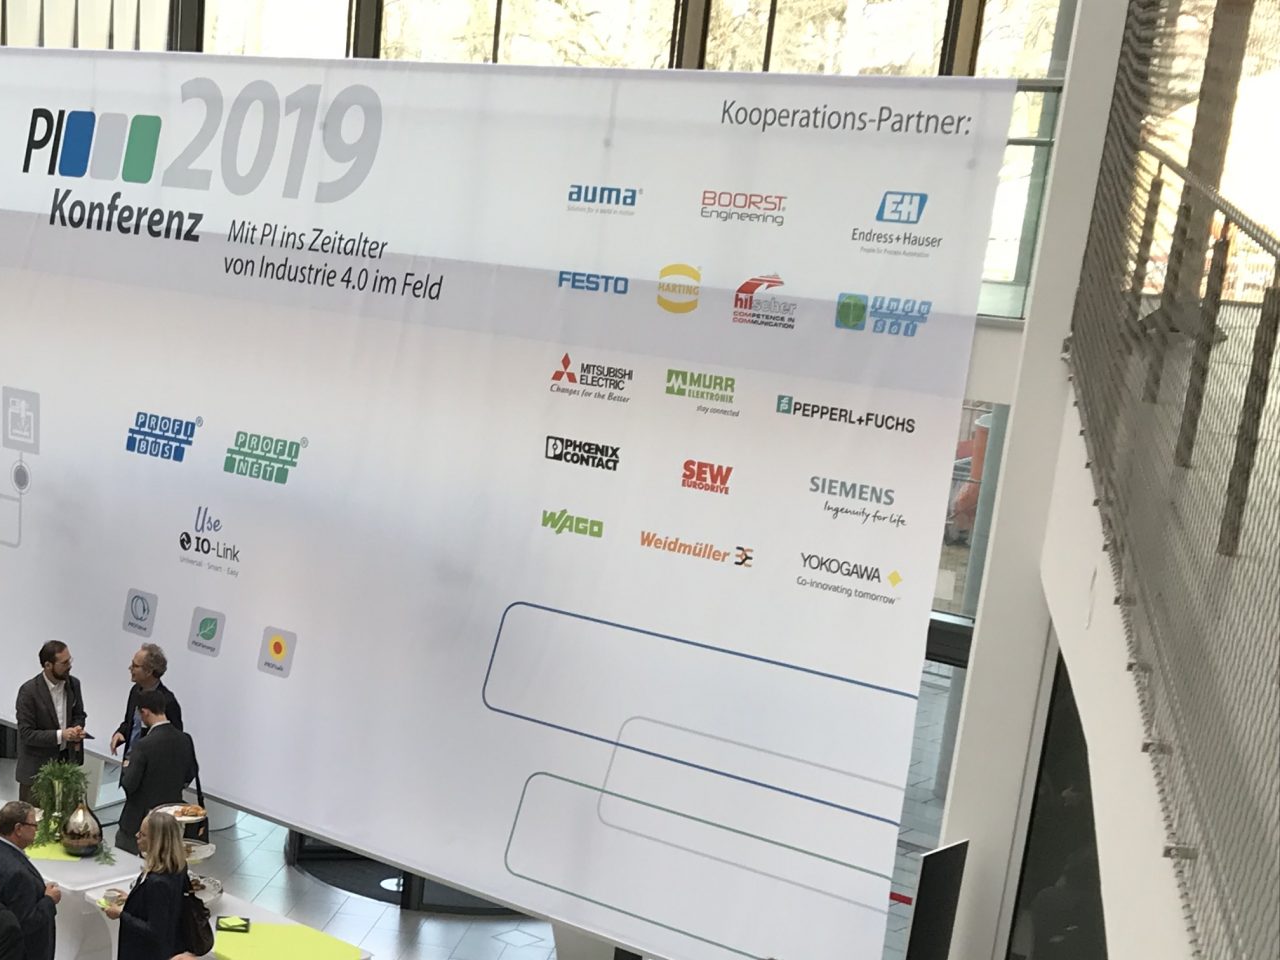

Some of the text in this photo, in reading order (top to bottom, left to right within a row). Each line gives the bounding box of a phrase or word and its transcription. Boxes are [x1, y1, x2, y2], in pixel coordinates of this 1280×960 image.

[721, 100, 972, 135] Kooperations-Partner:
[22, 107, 66, 175] PI
[161, 77, 383, 203] 2019
[568, 184, 637, 206] auma
[702, 190, 787, 212] BOORST
[50, 188, 204, 243] Konferenz
[700, 207, 785, 226] Engineering
[227, 219, 388, 260] Mit PI ins Zeitalter
[224, 256, 443, 301] von Industrie 4.0 im Feld
[558, 270, 629, 295] FESTO
[657, 281, 701, 296] HARTING
[733, 311, 785, 322] COMPETENCE
[734, 293, 797, 315] hilscher
[732, 317, 795, 330] COMMUNICATION
[580, 375, 625, 391] ELECTRIC
[581, 363, 633, 380] MITSUBISHI
[689, 372, 736, 393] MURR
[549, 383, 631, 403] Changes for the Better
[688, 389, 734, 404] ELEKTRONIK
[696, 405, 740, 417] stay connected
[792, 401, 916, 433] PEPPERL+FUCHS
[136, 412, 195, 437] PROFI
[137, 438, 172, 460] BUS
[235, 431, 300, 459] PROFI
[236, 458, 275, 481] NET
[563, 451, 619, 471] CONTACT
[682, 459, 733, 486] SEW
[681, 478, 729, 495] EURODRIVE
[809, 475, 895, 506] SIEMENS
[195, 506, 222, 533] Use
[541, 509, 604, 538] WAGO
[823, 500, 907, 528] Ingenuity for life
[194, 536, 240, 563] IO-Link
[639, 530, 731, 563] Weidmüller
[800, 552, 881, 583] YOKOGAWA
[796, 575, 896, 605] Co-innovating tomorrow
